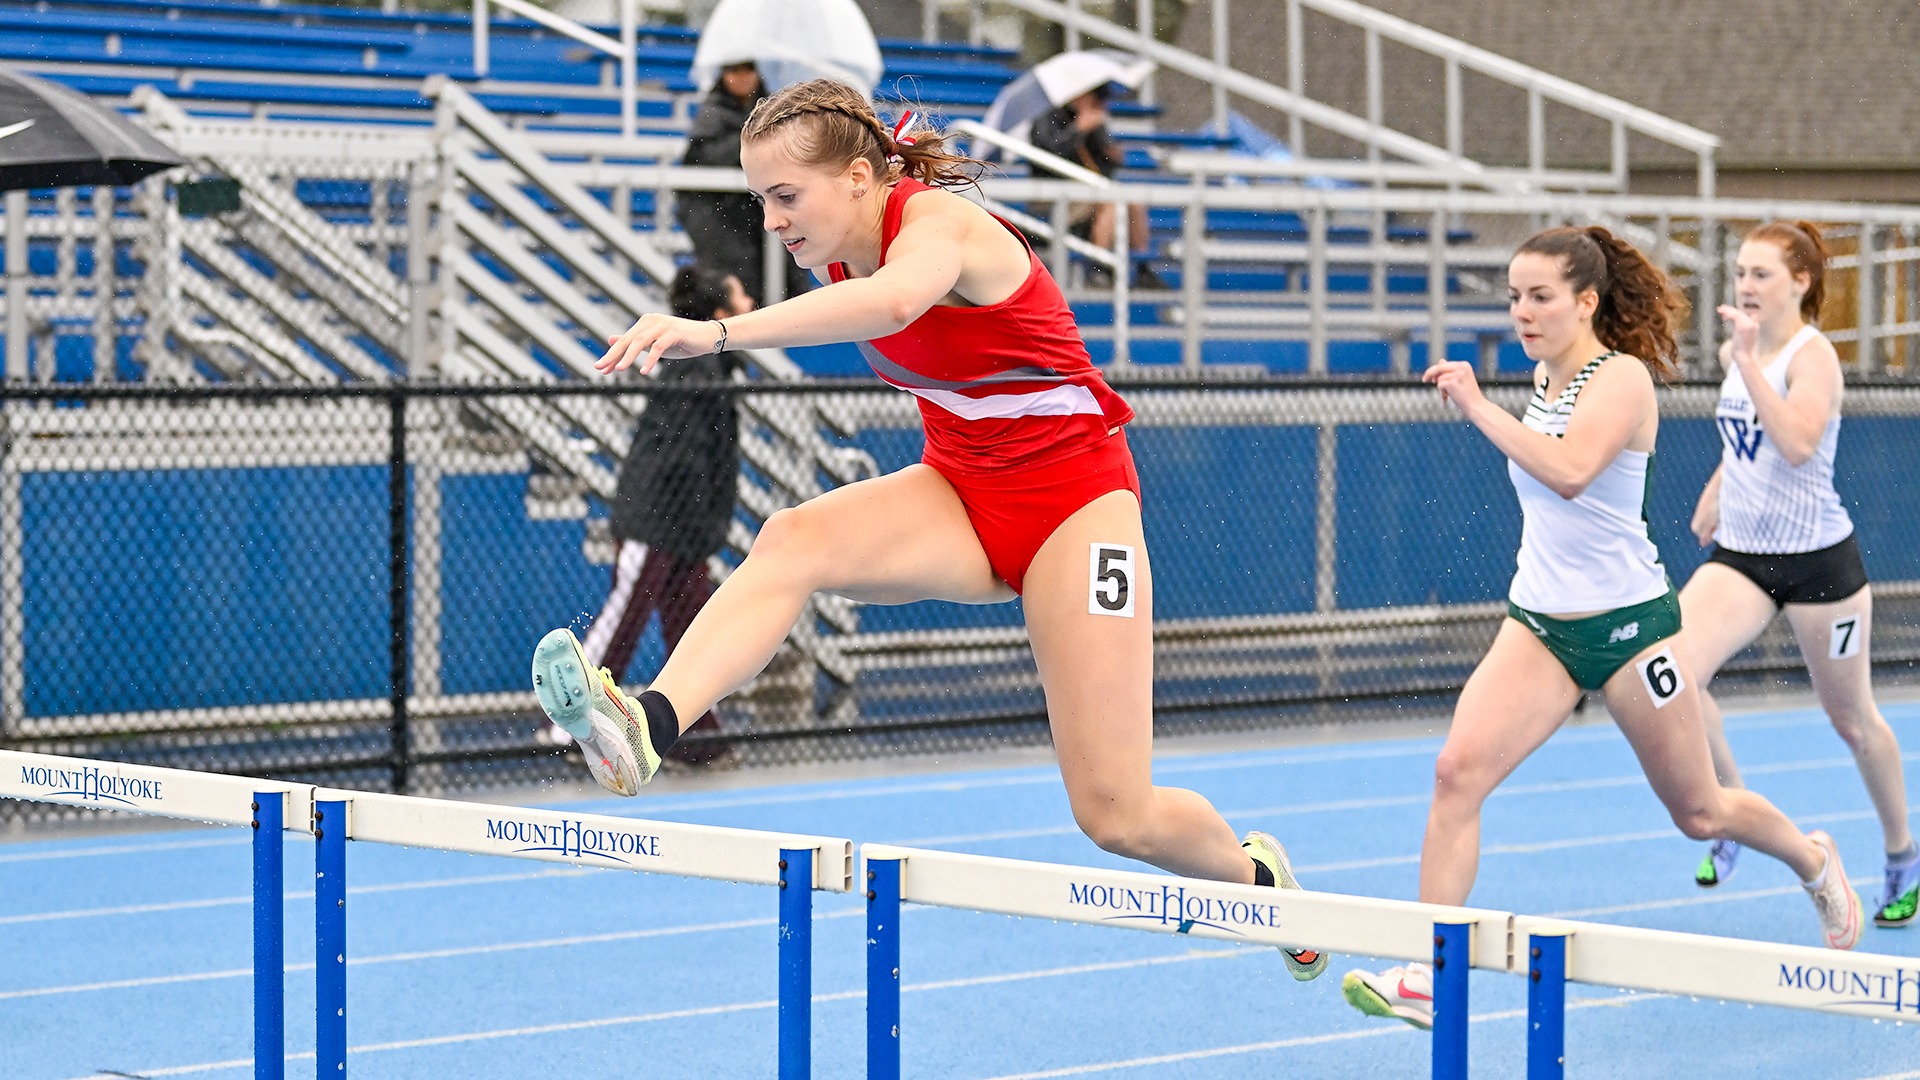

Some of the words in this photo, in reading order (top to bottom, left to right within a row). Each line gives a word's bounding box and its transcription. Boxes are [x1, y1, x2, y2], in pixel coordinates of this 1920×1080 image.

[1095, 547, 1129, 611] 5
[1608, 621, 1640, 643] NB
[1836, 619, 1857, 656] 7
[1645, 656, 1678, 699] 6
